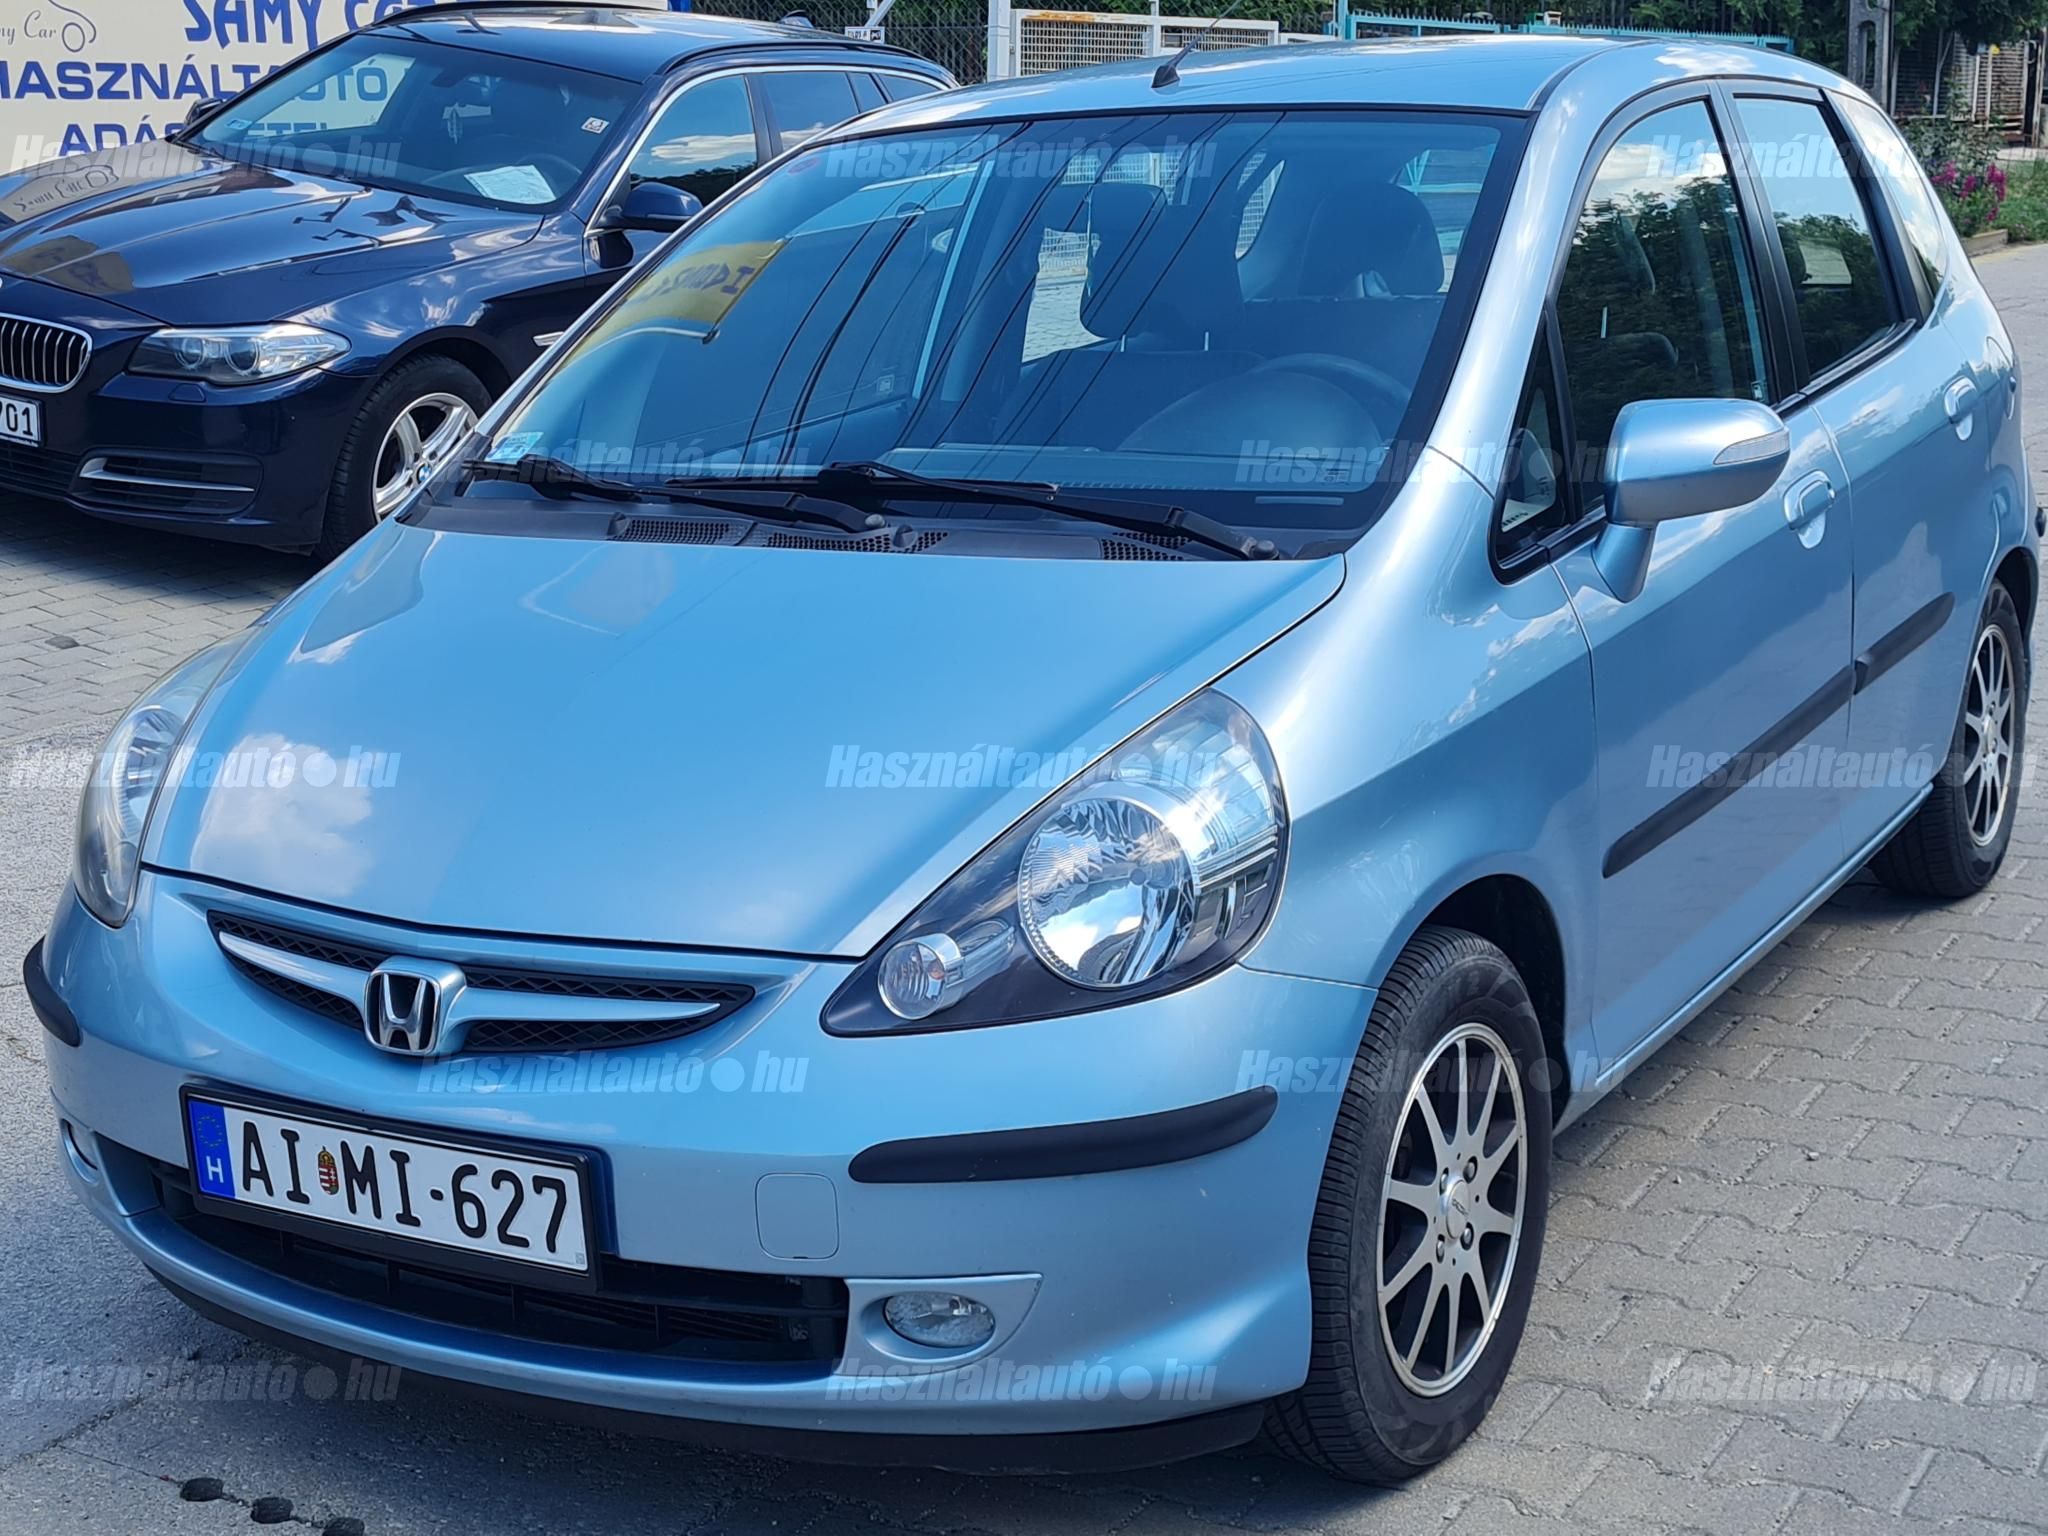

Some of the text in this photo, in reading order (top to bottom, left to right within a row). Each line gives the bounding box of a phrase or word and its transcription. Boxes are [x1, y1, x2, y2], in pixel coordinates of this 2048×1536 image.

[24, 10, 56, 38] Car
[183, 0, 319, 50] SAMY
[0, 402, 34, 436] 01
[206, 1155, 225, 1184] H
